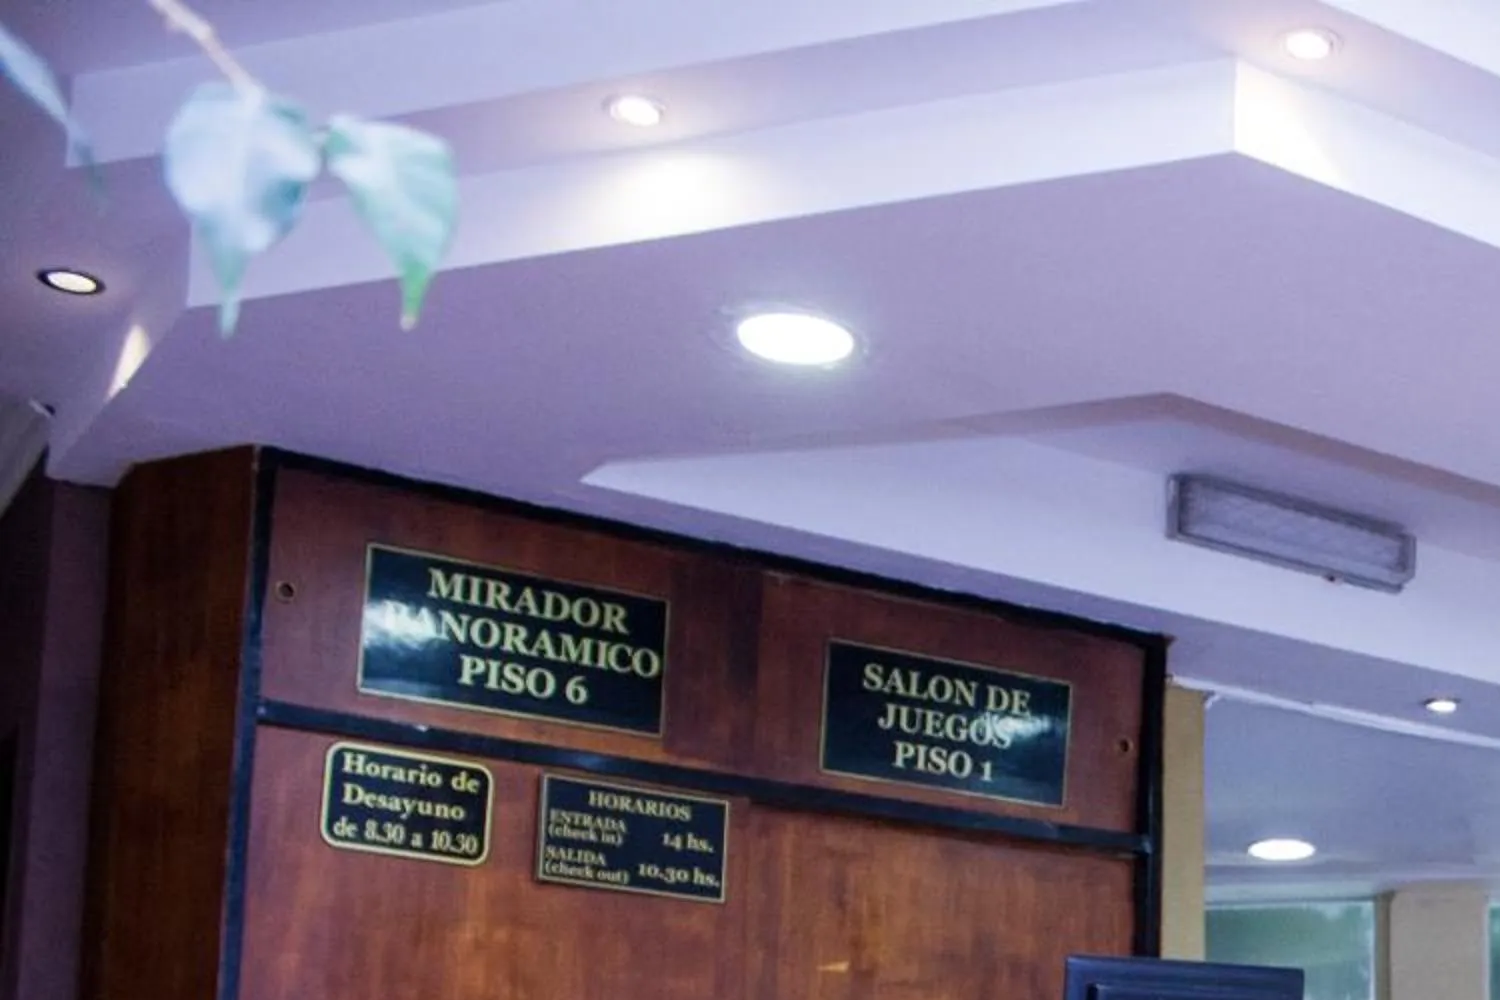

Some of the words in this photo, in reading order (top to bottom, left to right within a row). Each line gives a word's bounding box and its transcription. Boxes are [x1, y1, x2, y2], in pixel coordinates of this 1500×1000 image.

[427, 566, 629, 635] MIRADOR
[458, 655, 556, 699] PISO
[565, 676, 589, 705] 6
[863, 662, 979, 707] SALON
[987, 684, 1031, 716] DE
[877, 703, 1012, 749] JUEGOS
[342, 752, 443, 787] Horario
[450, 771, 481, 793] de
[892, 740, 972, 779] PISO
[980, 761, 994, 782] 1
[342, 782, 466, 821] Desayuno
[549, 808, 628, 834] ENTRADA
[588, 790, 692, 822] HORARIOS
[332, 815, 358, 838] de
[364, 819, 406, 844] 8.30
[410, 832, 423, 848] a
[431, 829, 479, 856] 10.30
[545, 845, 607, 867] SALIDA
[662, 832, 682, 851] 14
[687, 833, 714, 853] hs.
[638, 863, 689, 885] 10.30
[693, 866, 721, 888] hs.
